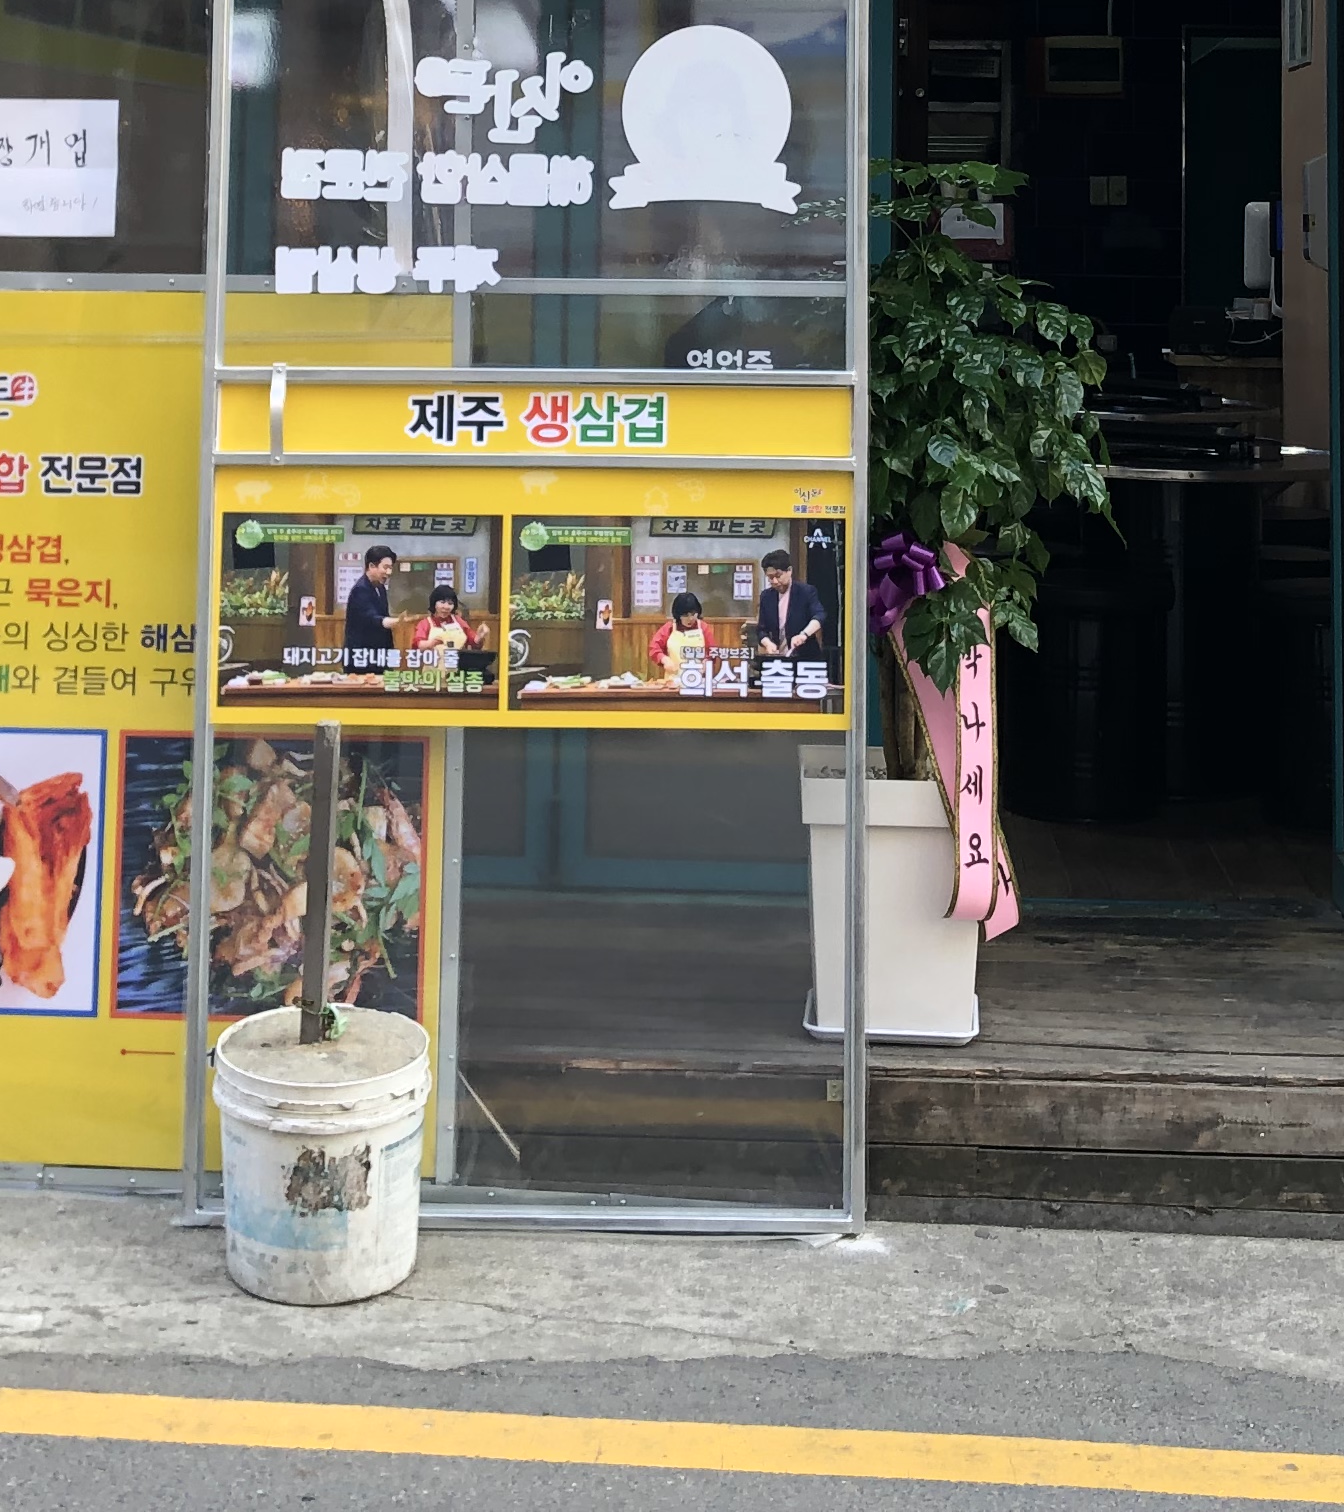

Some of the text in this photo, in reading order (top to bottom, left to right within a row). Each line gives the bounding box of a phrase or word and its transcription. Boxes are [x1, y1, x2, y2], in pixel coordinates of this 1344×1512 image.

[409, 392, 666, 445] 제주 생삼겹
[39, 454, 144, 496] 전문점
[24, 577, 119, 610] 묵은지,
[41, 621, 131, 653] 싱싱한
[282, 646, 349, 667] 돼지고기
[351, 647, 402, 668] 잡내를
[405, 648, 439, 669] 잡아
[52, 664, 137, 697] 곁들여
[383, 669, 442, 692] 불맛의
[679, 659, 829, 699] 희석 출동
